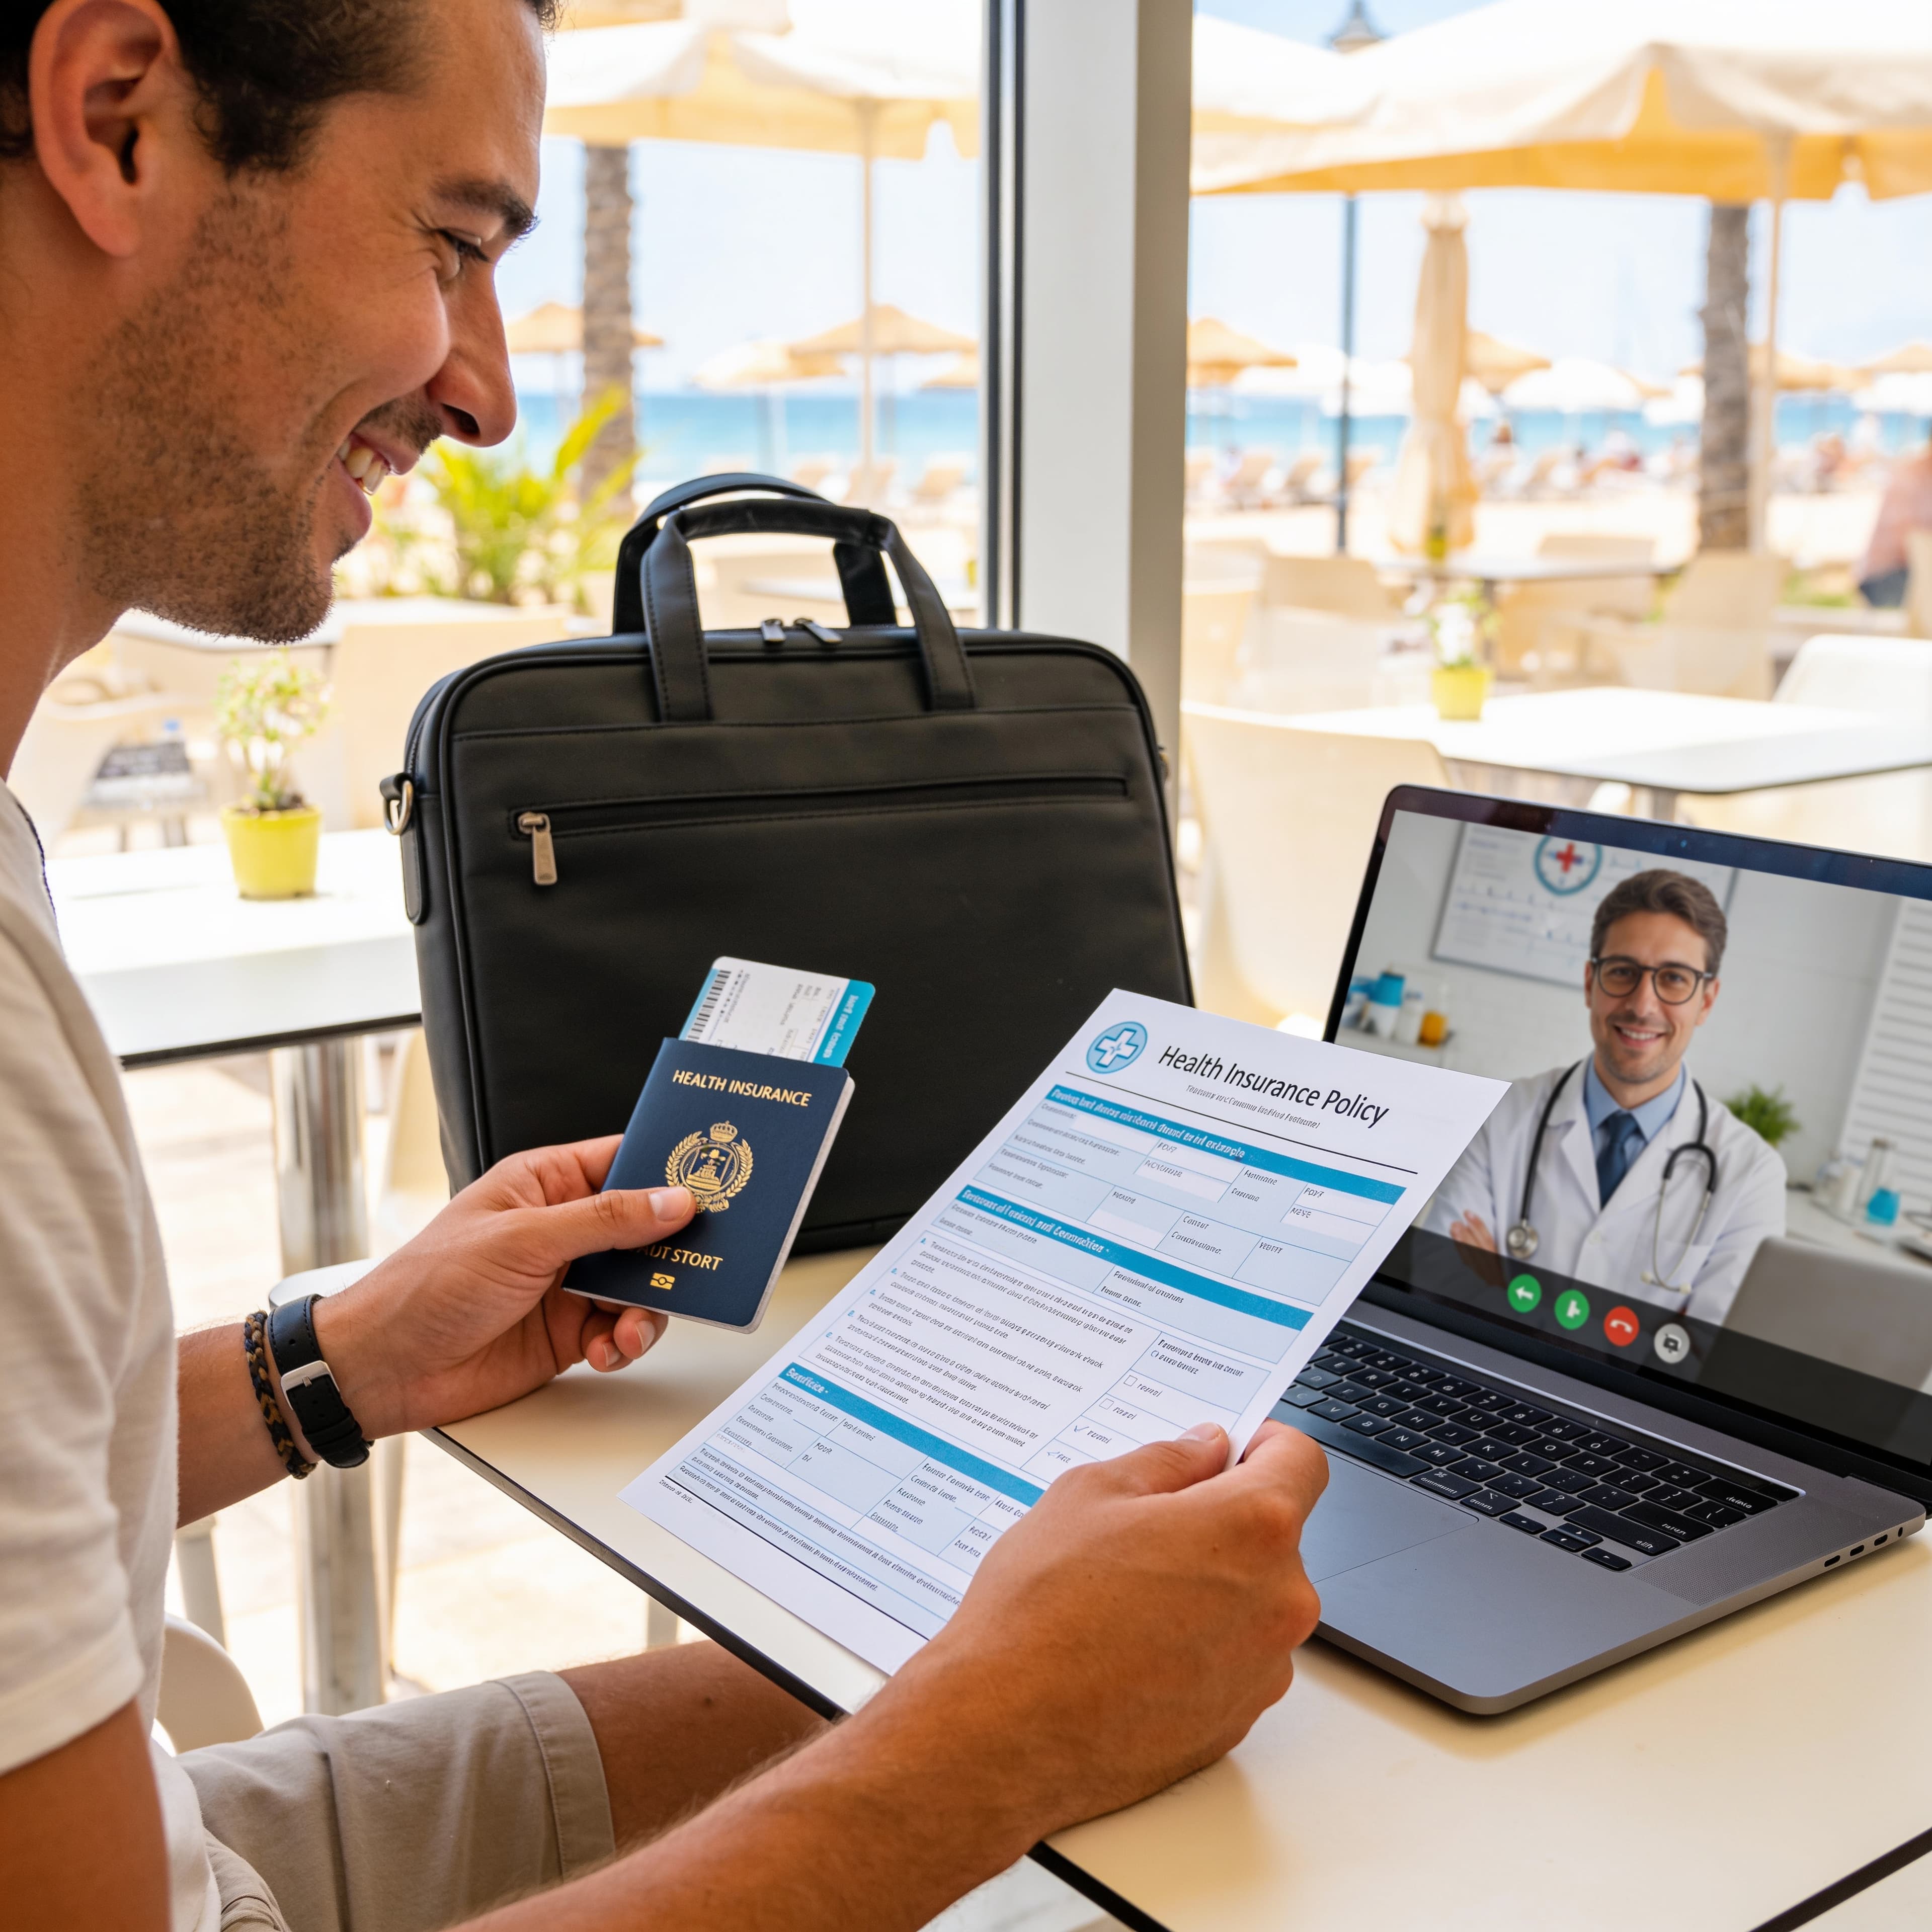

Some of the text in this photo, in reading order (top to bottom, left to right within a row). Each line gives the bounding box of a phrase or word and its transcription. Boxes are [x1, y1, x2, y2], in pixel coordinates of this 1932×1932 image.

[672, 1070, 812, 1107] HEALTH INSURANCE
[1158, 1045, 1223, 1080] Health
[1224, 1063, 1320, 1106] Insurance
[1321, 1089, 1390, 1129] Policy
[671, 1249, 723, 1271] STORT
